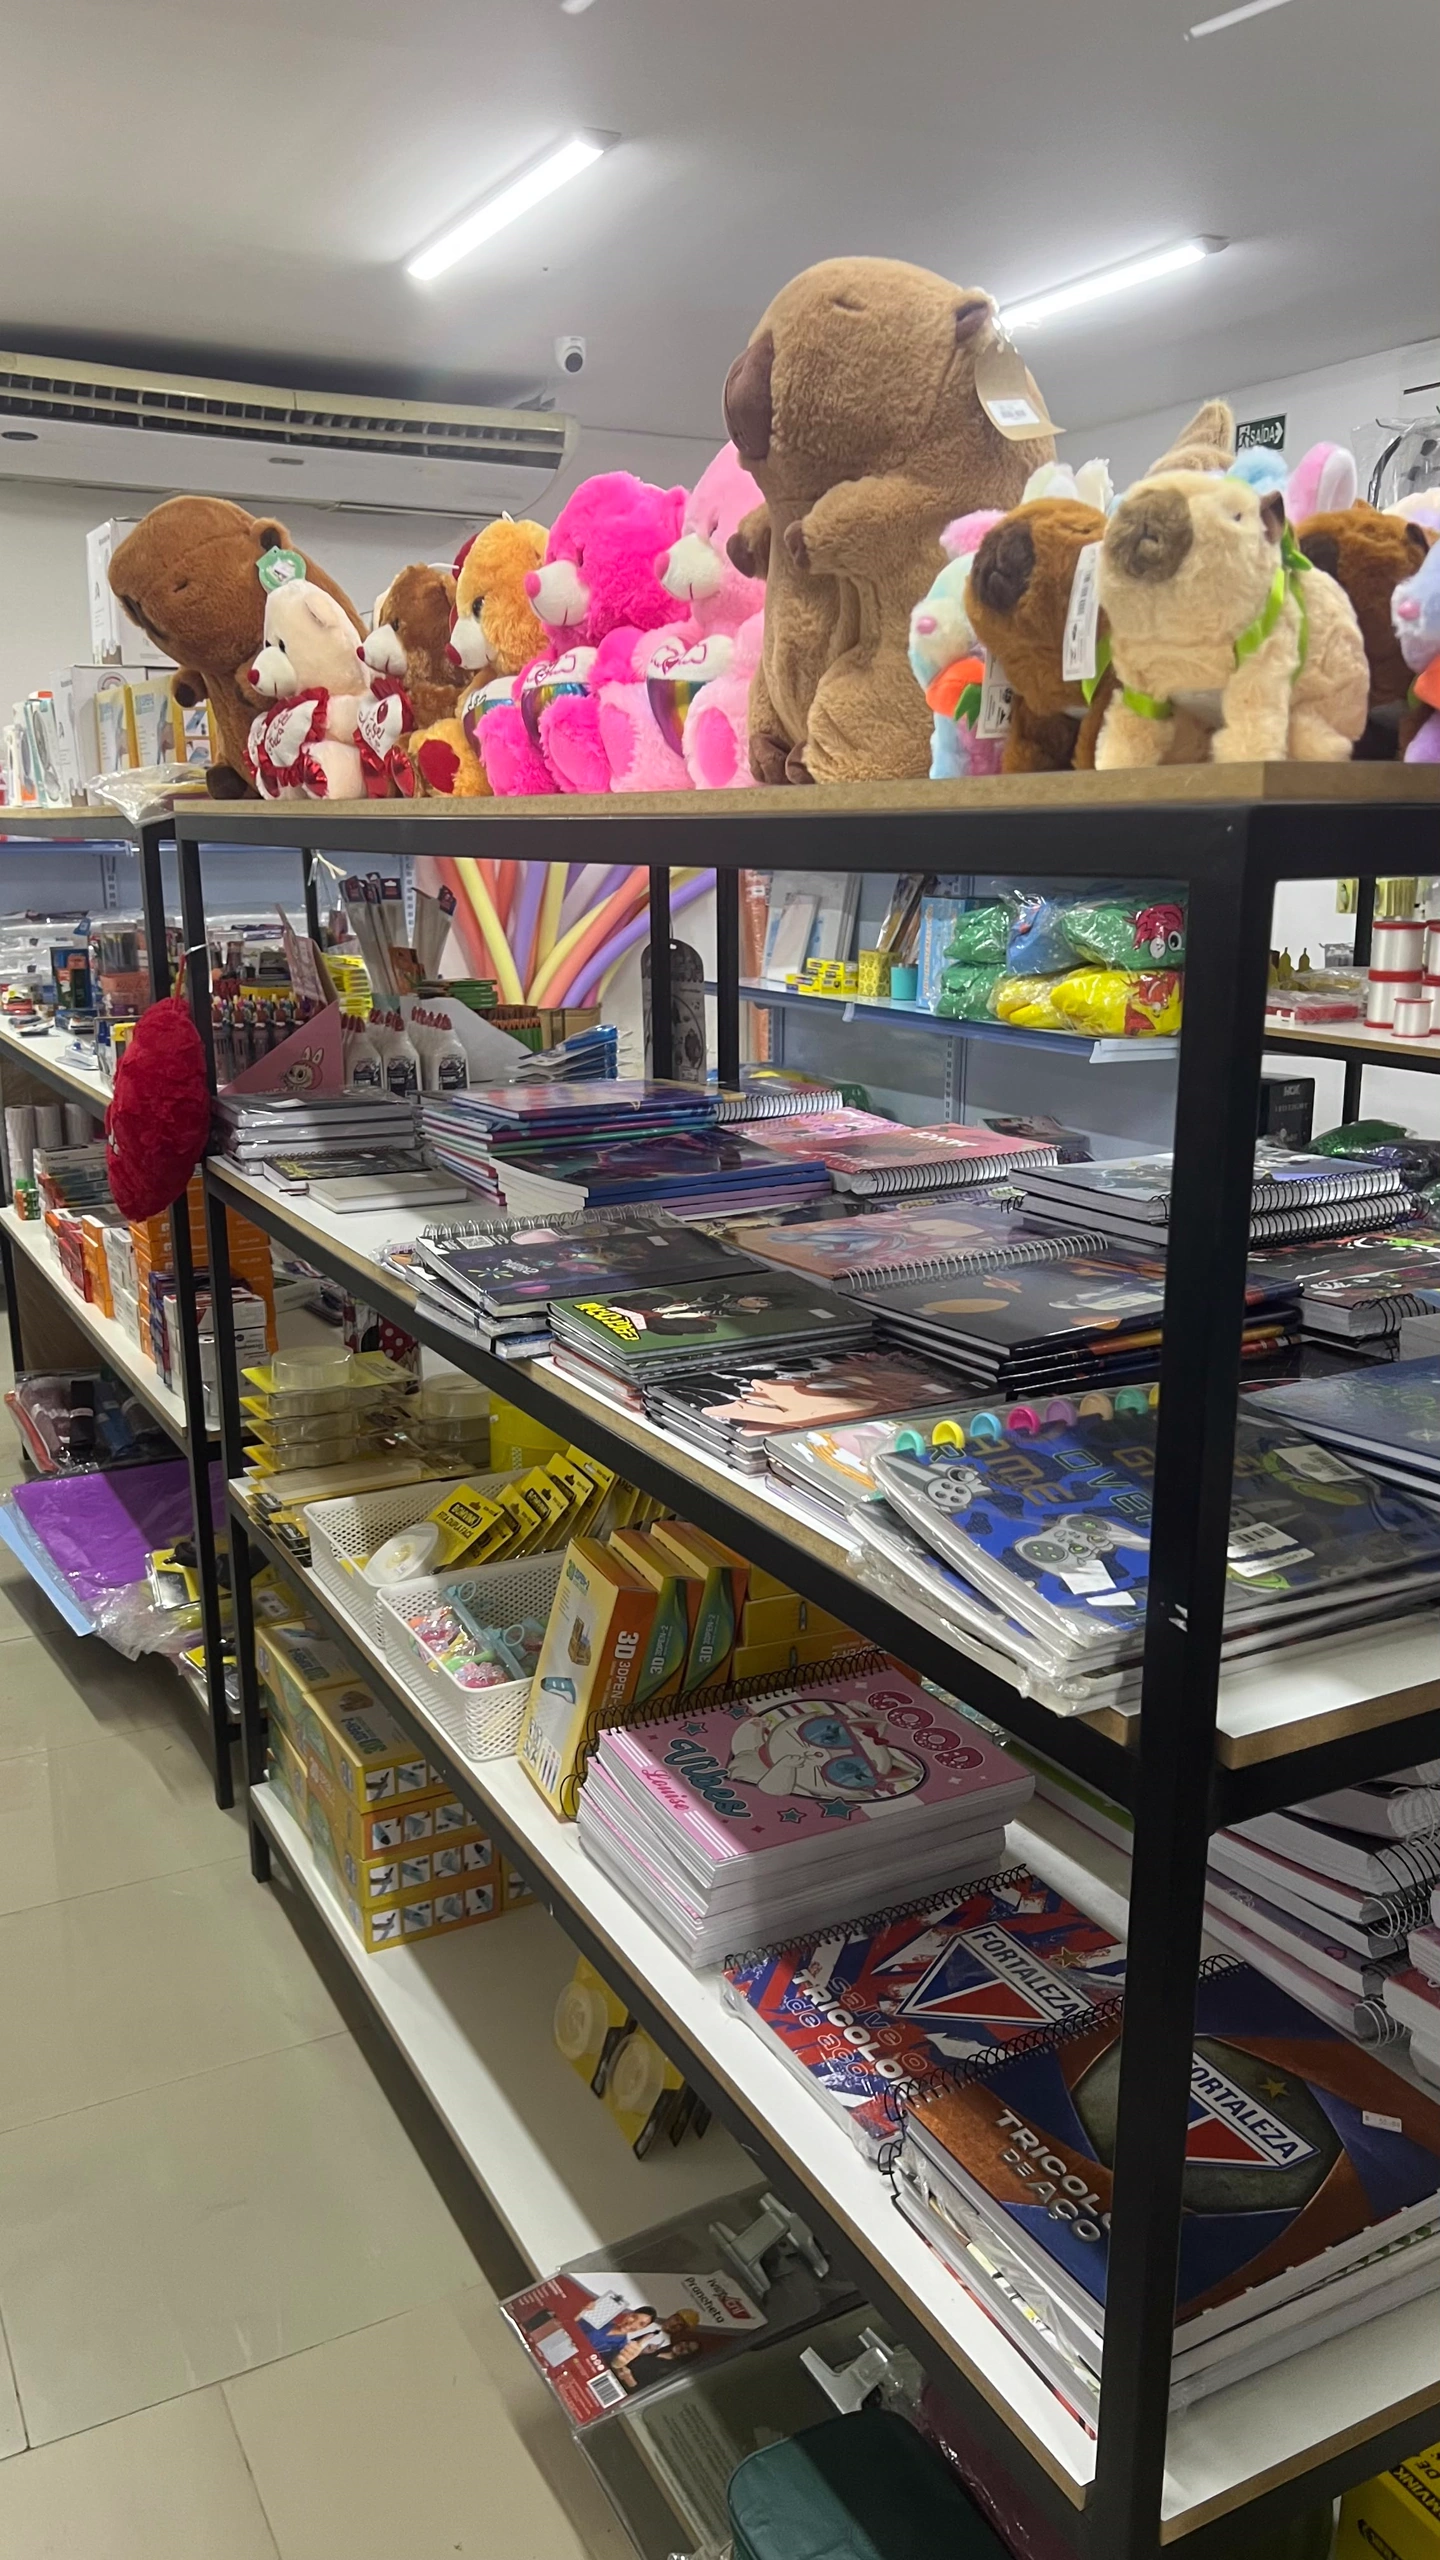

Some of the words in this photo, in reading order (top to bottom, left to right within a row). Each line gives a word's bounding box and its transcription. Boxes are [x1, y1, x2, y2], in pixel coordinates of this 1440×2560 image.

[1250, 424, 1275, 445] SAÍDA
[614, 1630, 639, 1659] 3D
[650, 1656, 665, 1675] 3D
[698, 1645, 714, 1663] 3D
[867, 1690, 985, 1770] GOOD
[641, 1769, 690, 1811] Louise
[663, 1738, 752, 1818] Vibes
[972, 1931, 1080, 2018] FORTALEZA
[1191, 2059, 1299, 2160] ORTALEZA
[1003, 2148, 1035, 2177] DE
[1025, 2181, 1101, 2241] AÇO
[685, 2277, 724, 2323] Prancheta
